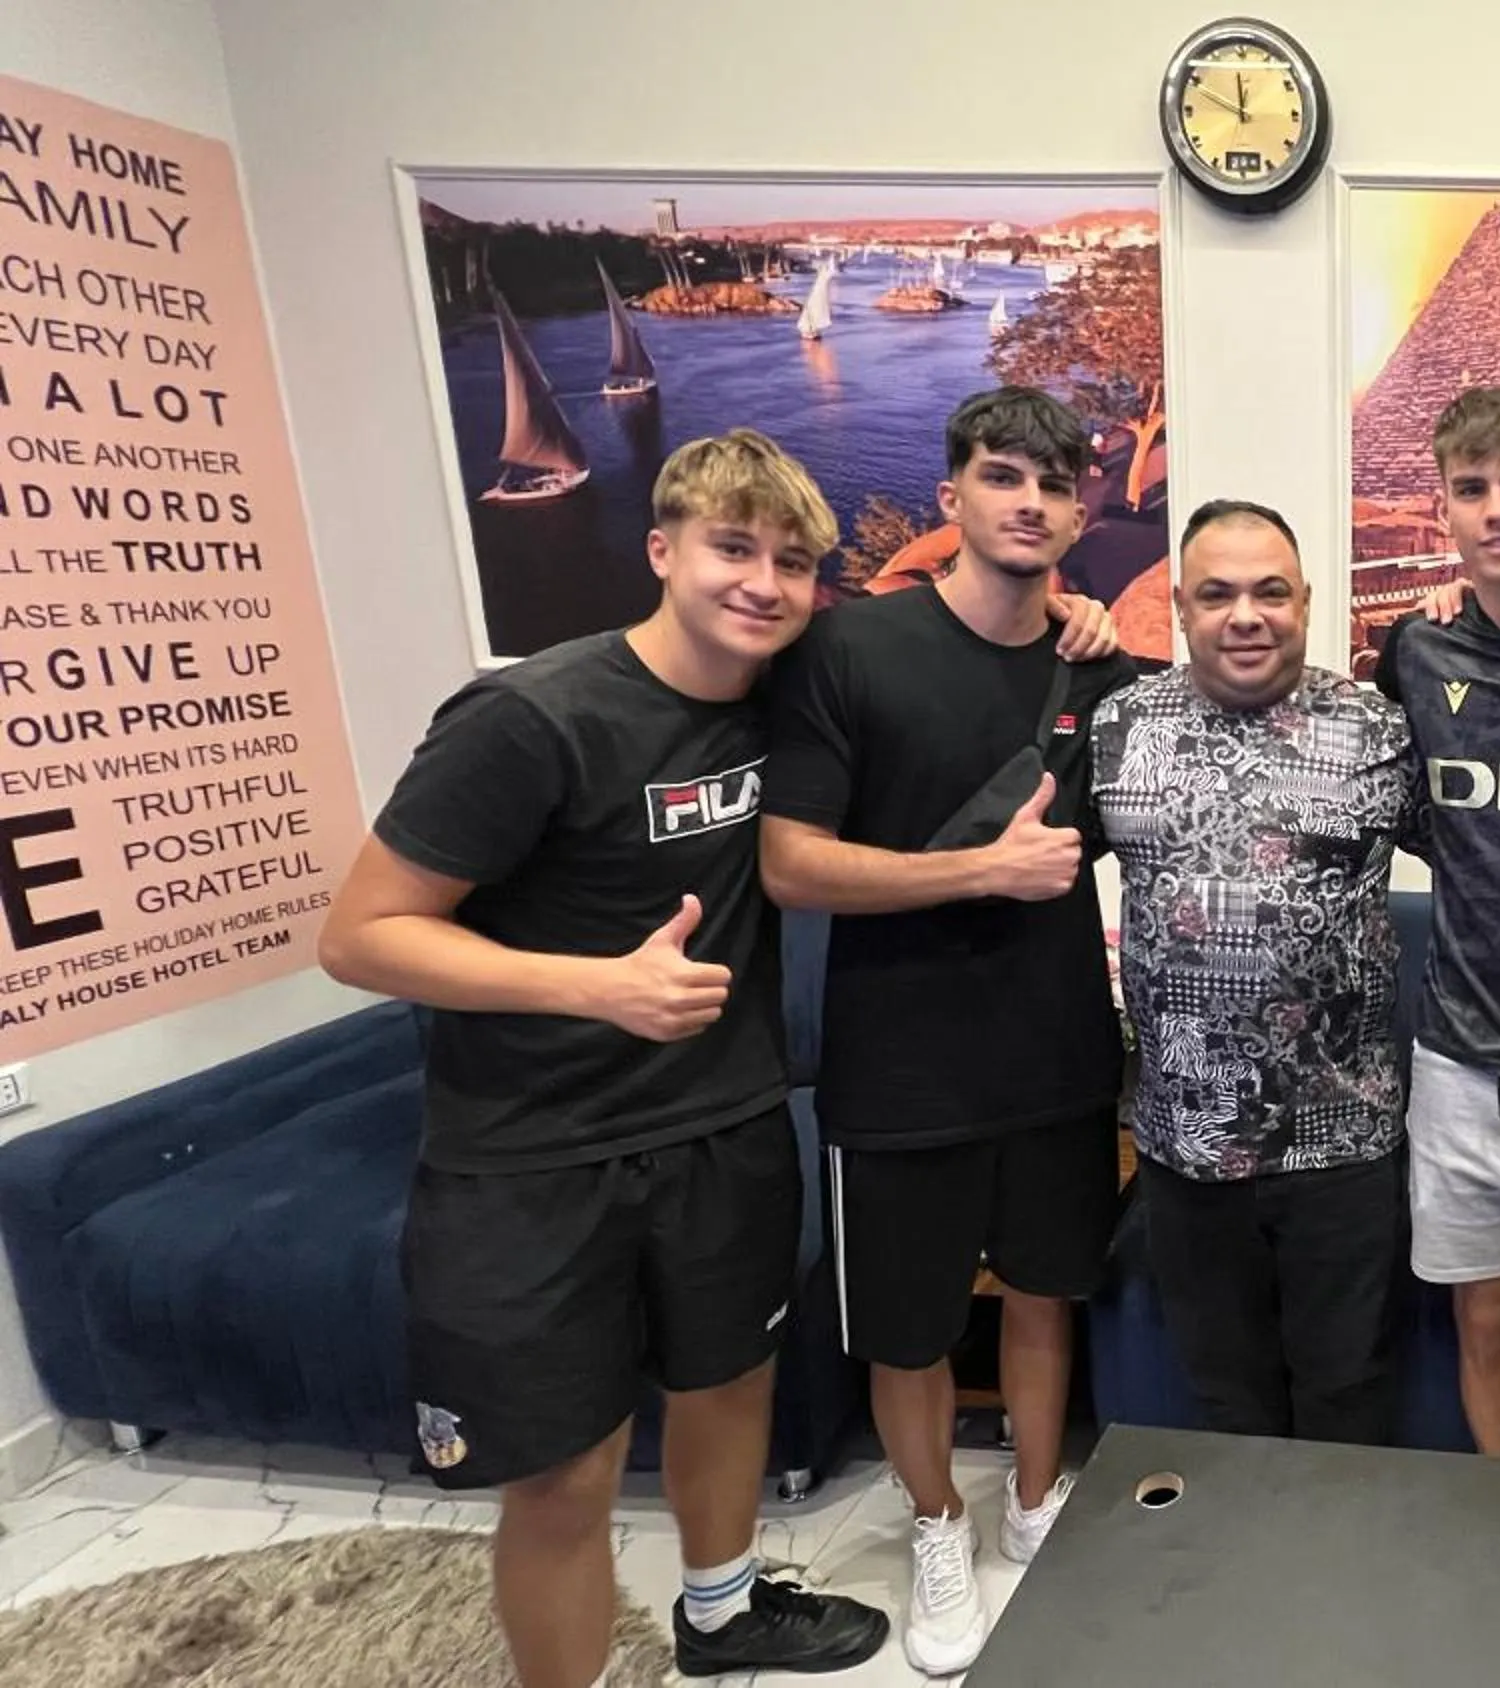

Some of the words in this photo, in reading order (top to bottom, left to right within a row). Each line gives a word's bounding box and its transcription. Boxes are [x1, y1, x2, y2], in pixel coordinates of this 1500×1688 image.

[67, 131, 187, 197] HOME
[0, 169, 191, 255] AMILY
[0, 253, 68, 301] CH
[75, 268, 213, 326] OTHER
[142, 333, 217, 372] DAY
[44, 371, 86, 415] A
[107, 377, 229, 428] LOT
[6, 435, 88, 466] ONE
[93, 441, 243, 476] ANOTHER
[69, 484, 253, 526] WORDS
[35, 548, 109, 575] THE
[109, 539, 263, 574] TRUTH
[0, 603, 73, 631] ASE
[79, 602, 103, 627] &
[105, 598, 212, 625] THANK
[210, 597, 272, 621] YOU
[45, 640, 203, 692] GIVE
[225, 642, 281, 678] UP
[0, 709, 112, 749] OUR
[117, 689, 293, 737] PROMISE
[0, 761, 89, 797] EVEN
[91, 748, 182, 782] WHEN
[185, 742, 228, 769] ITS
[230, 732, 299, 762] HARD
[111, 769, 309, 826] TRUTHFUL
[121, 808, 313, 873] POSITIVE
[0, 806, 106, 953] E
[135, 849, 324, 915] GRATEFUL
[54, 943, 132, 980] THESE
[132, 919, 217, 959] HOLIDAY
[218, 904, 275, 935] HOME
[275, 890, 332, 919] RULES
[0, 996, 51, 1031] ALY
[55, 969, 149, 1013] HOUSE
[150, 947, 232, 984] HOTEL
[231, 928, 292, 959] TEAM
